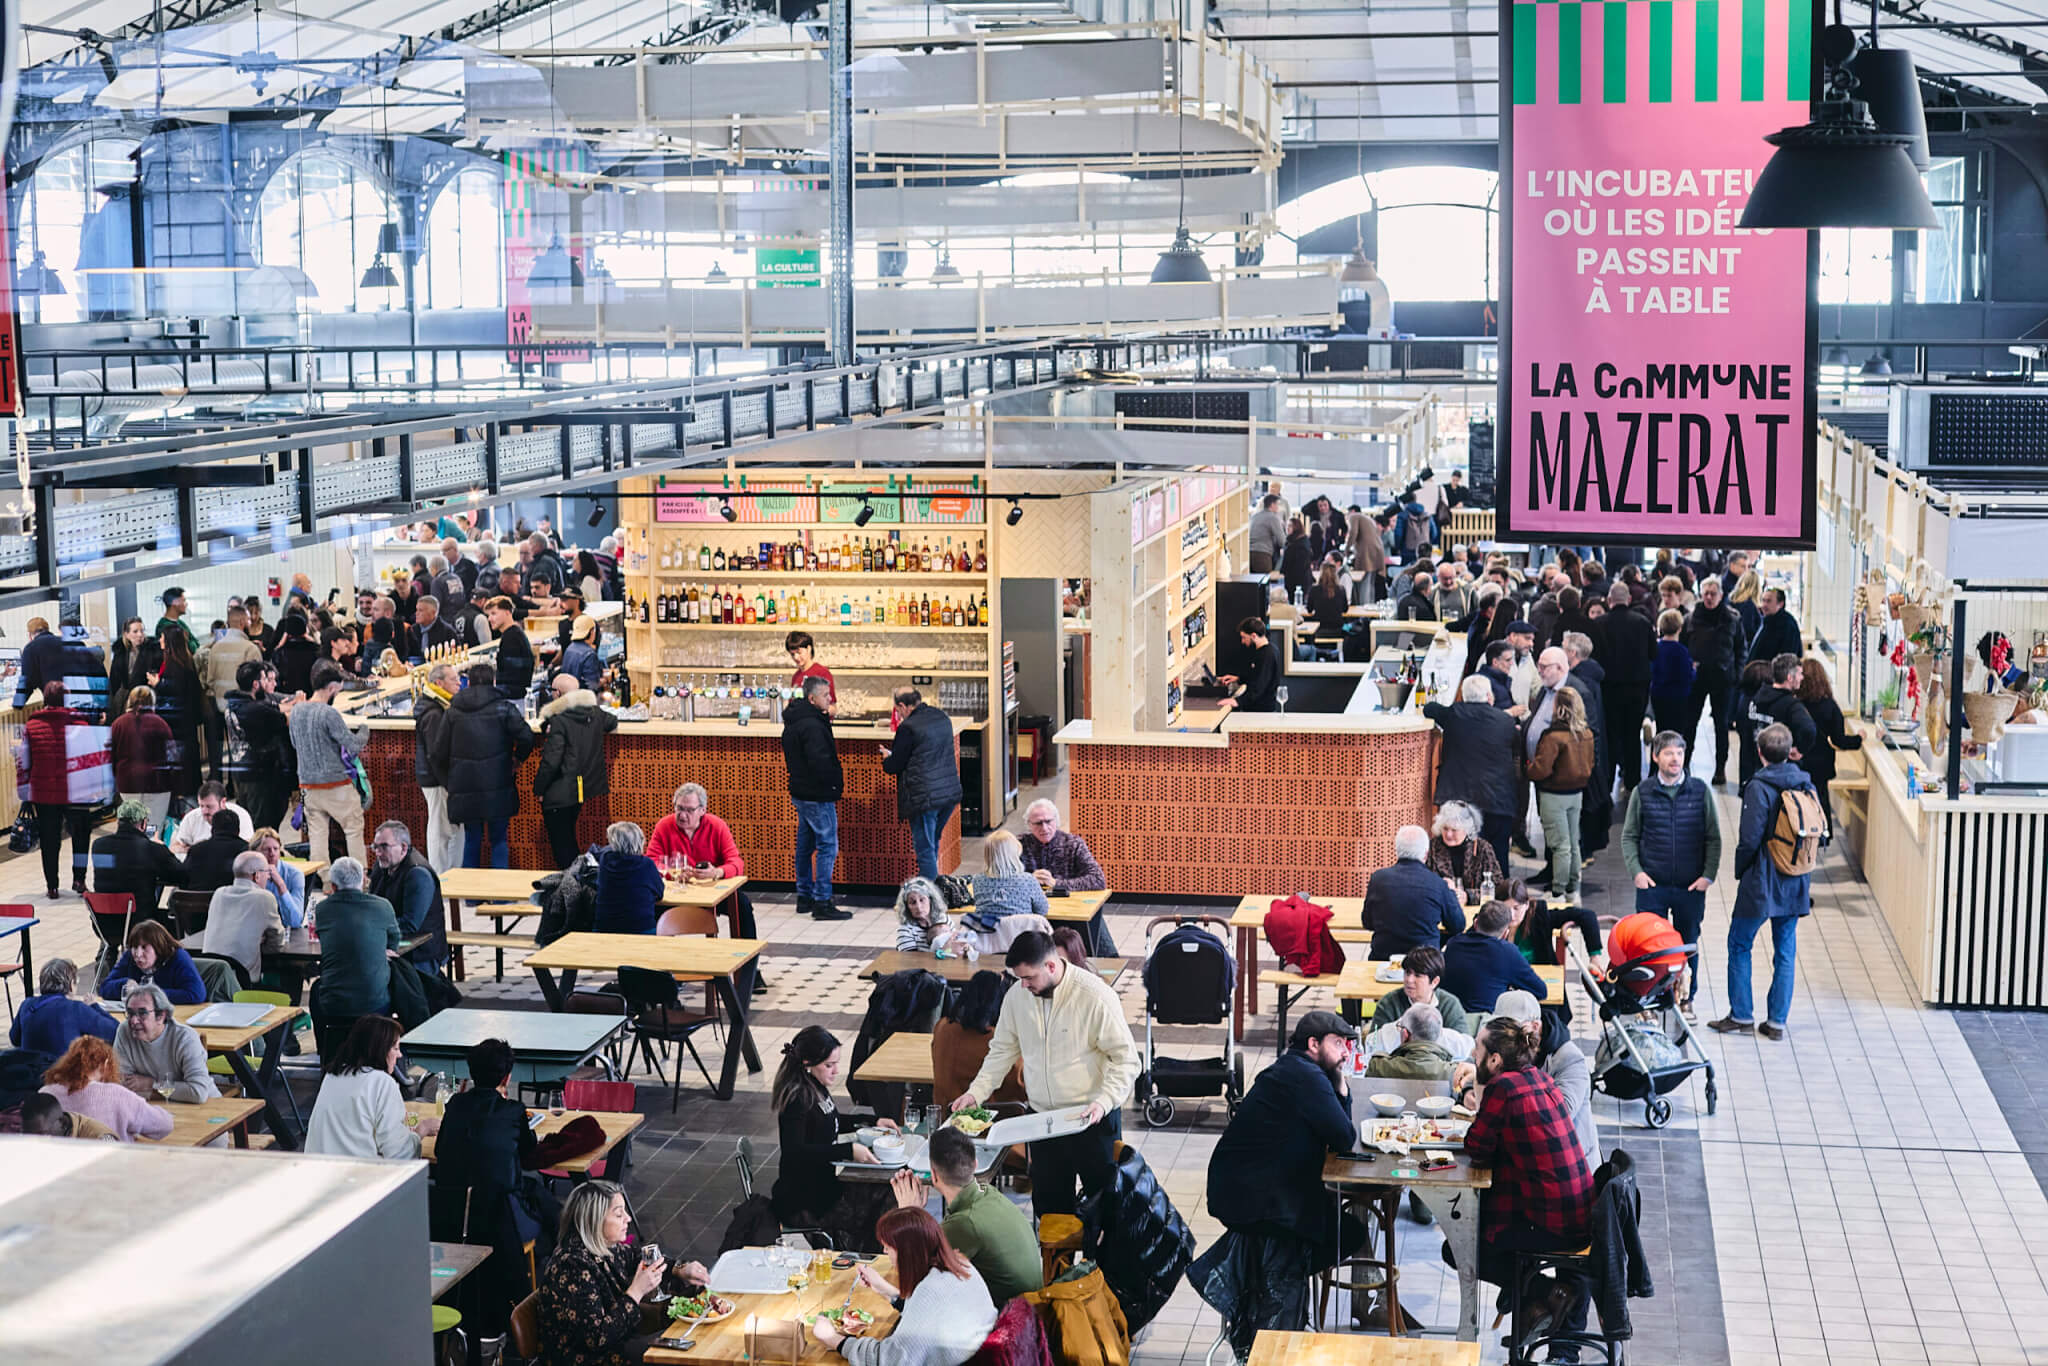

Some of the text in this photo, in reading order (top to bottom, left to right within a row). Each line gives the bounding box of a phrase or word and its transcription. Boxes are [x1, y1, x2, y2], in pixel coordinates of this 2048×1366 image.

[1544, 200, 1775, 236] OÙ LES IDÉ
[761, 263, 816, 272] LA CULTURE
[1576, 247, 1741, 275] PASSENT
[1585, 277, 1730, 314] À TABLE
[512, 311, 527, 323] LA
[1531, 362, 1578, 398] LA
[1528, 411, 1790, 515] MAZERAT
